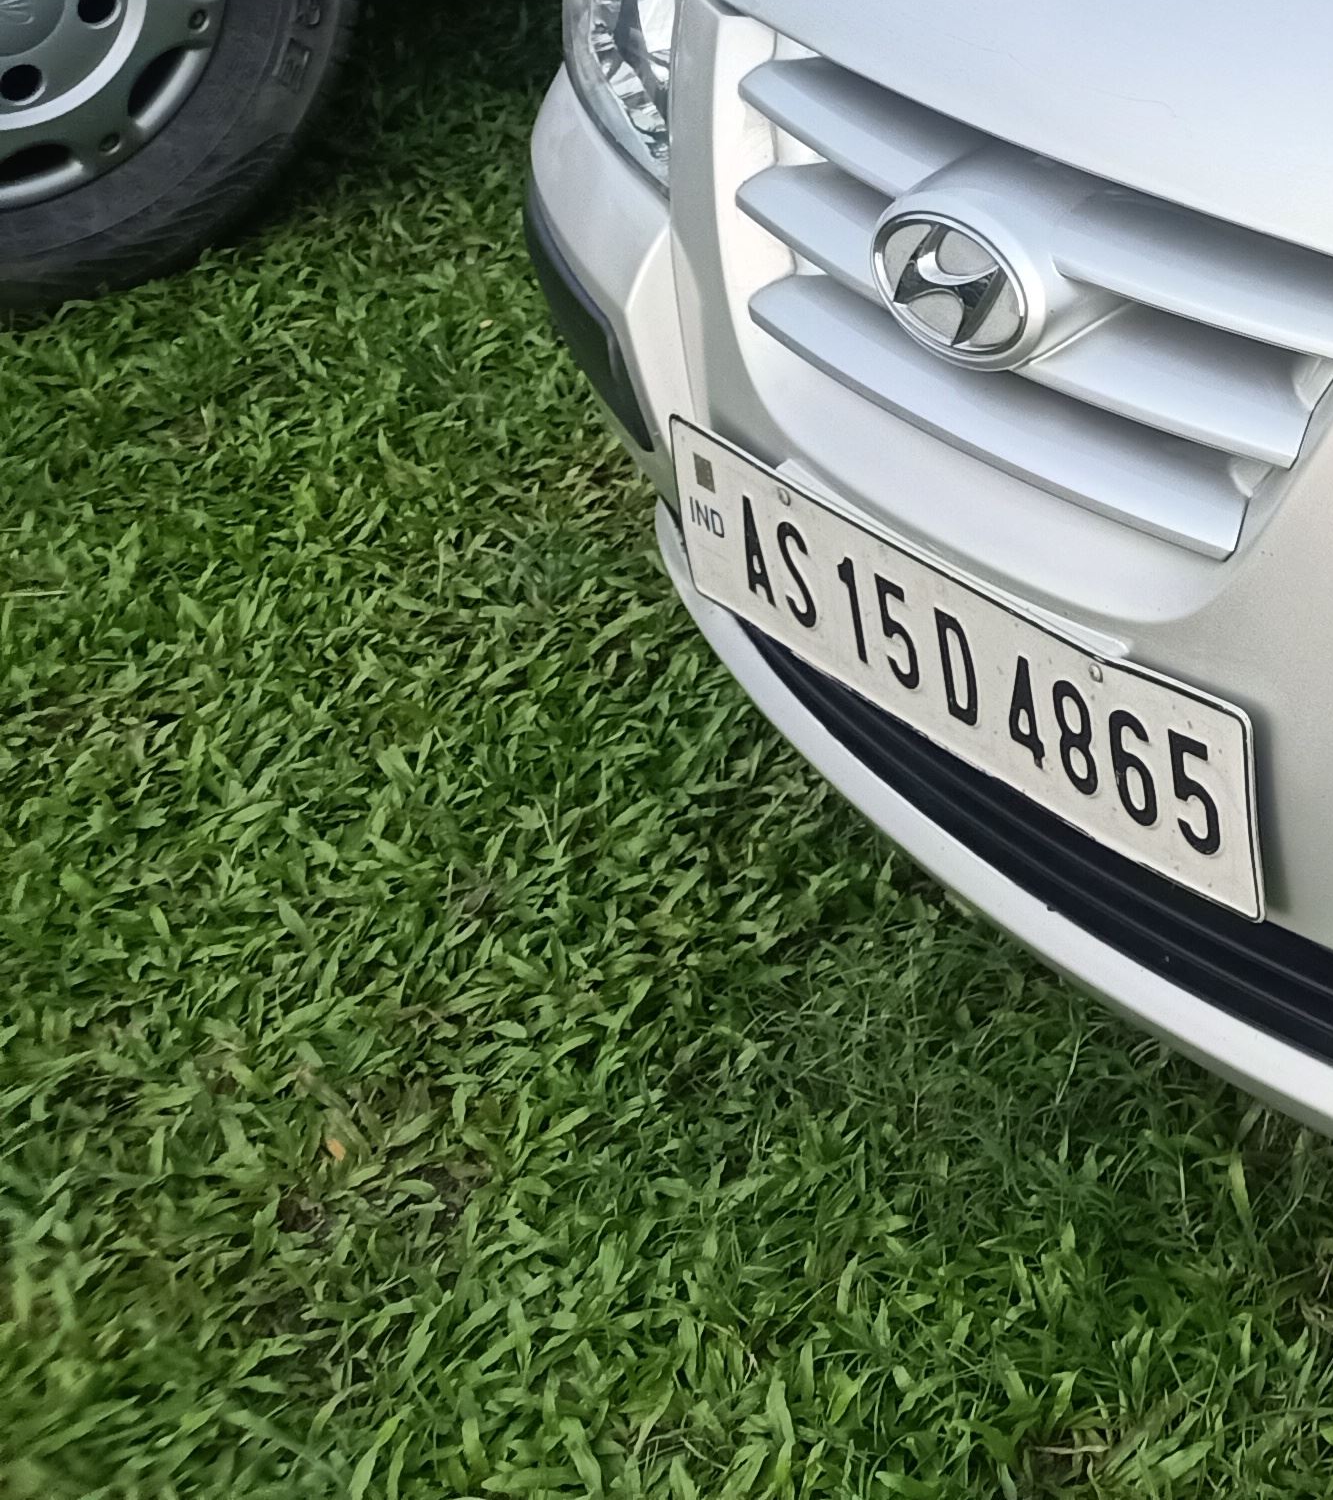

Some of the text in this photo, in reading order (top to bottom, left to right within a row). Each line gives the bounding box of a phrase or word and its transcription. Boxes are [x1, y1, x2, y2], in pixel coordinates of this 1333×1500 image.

[689, 496, 725, 539] IND
[742, 495, 1221, 856] AS 15 D 4865
